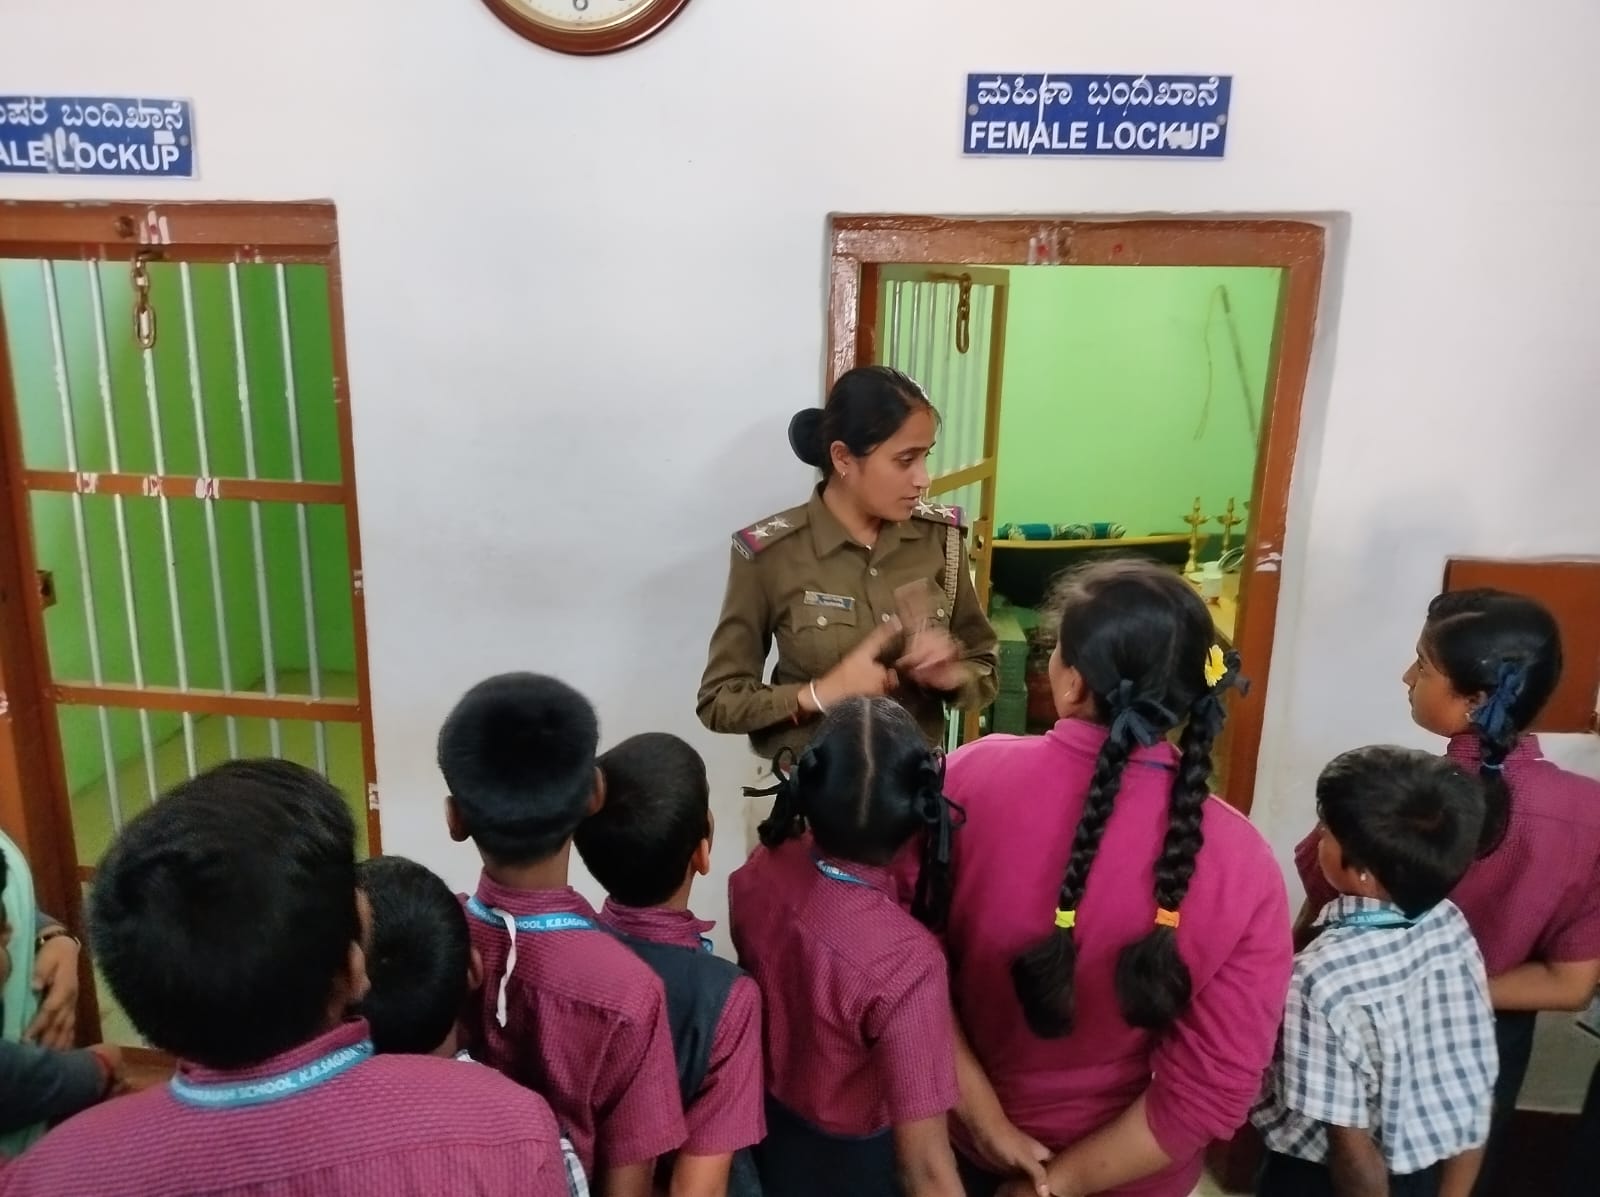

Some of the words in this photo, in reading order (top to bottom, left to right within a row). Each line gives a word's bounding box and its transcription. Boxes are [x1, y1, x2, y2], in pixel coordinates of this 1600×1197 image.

[970, 121, 1088, 149] FEMALE
[1096, 121, 1220, 150] LOCKUP
[57, 141, 180, 171] LOCKUP
